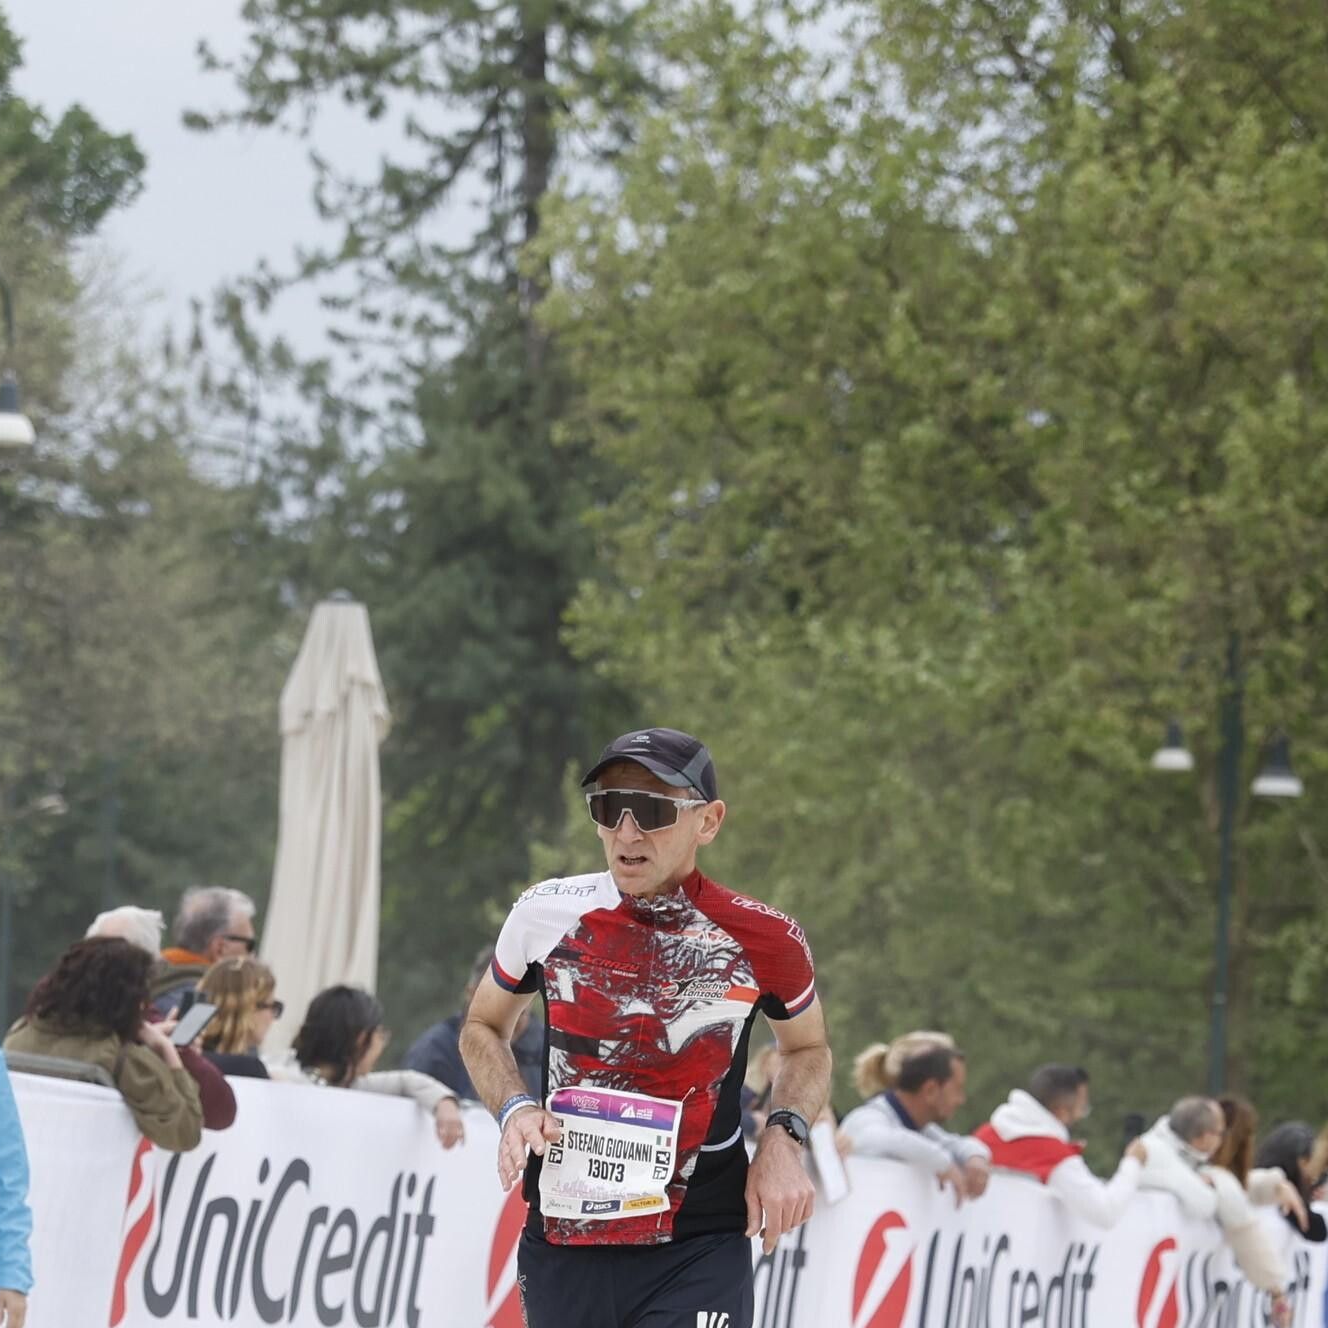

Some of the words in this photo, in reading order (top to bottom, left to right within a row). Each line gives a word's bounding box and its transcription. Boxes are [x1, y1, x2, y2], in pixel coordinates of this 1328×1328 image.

[683, 989, 723, 999] Lanzada
[690, 981, 730, 992] Sportiva
[567, 1130, 605, 1156] STEFANO
[606, 1138, 653, 1163] GIOVANNI
[587, 1158, 625, 1182] 13073
